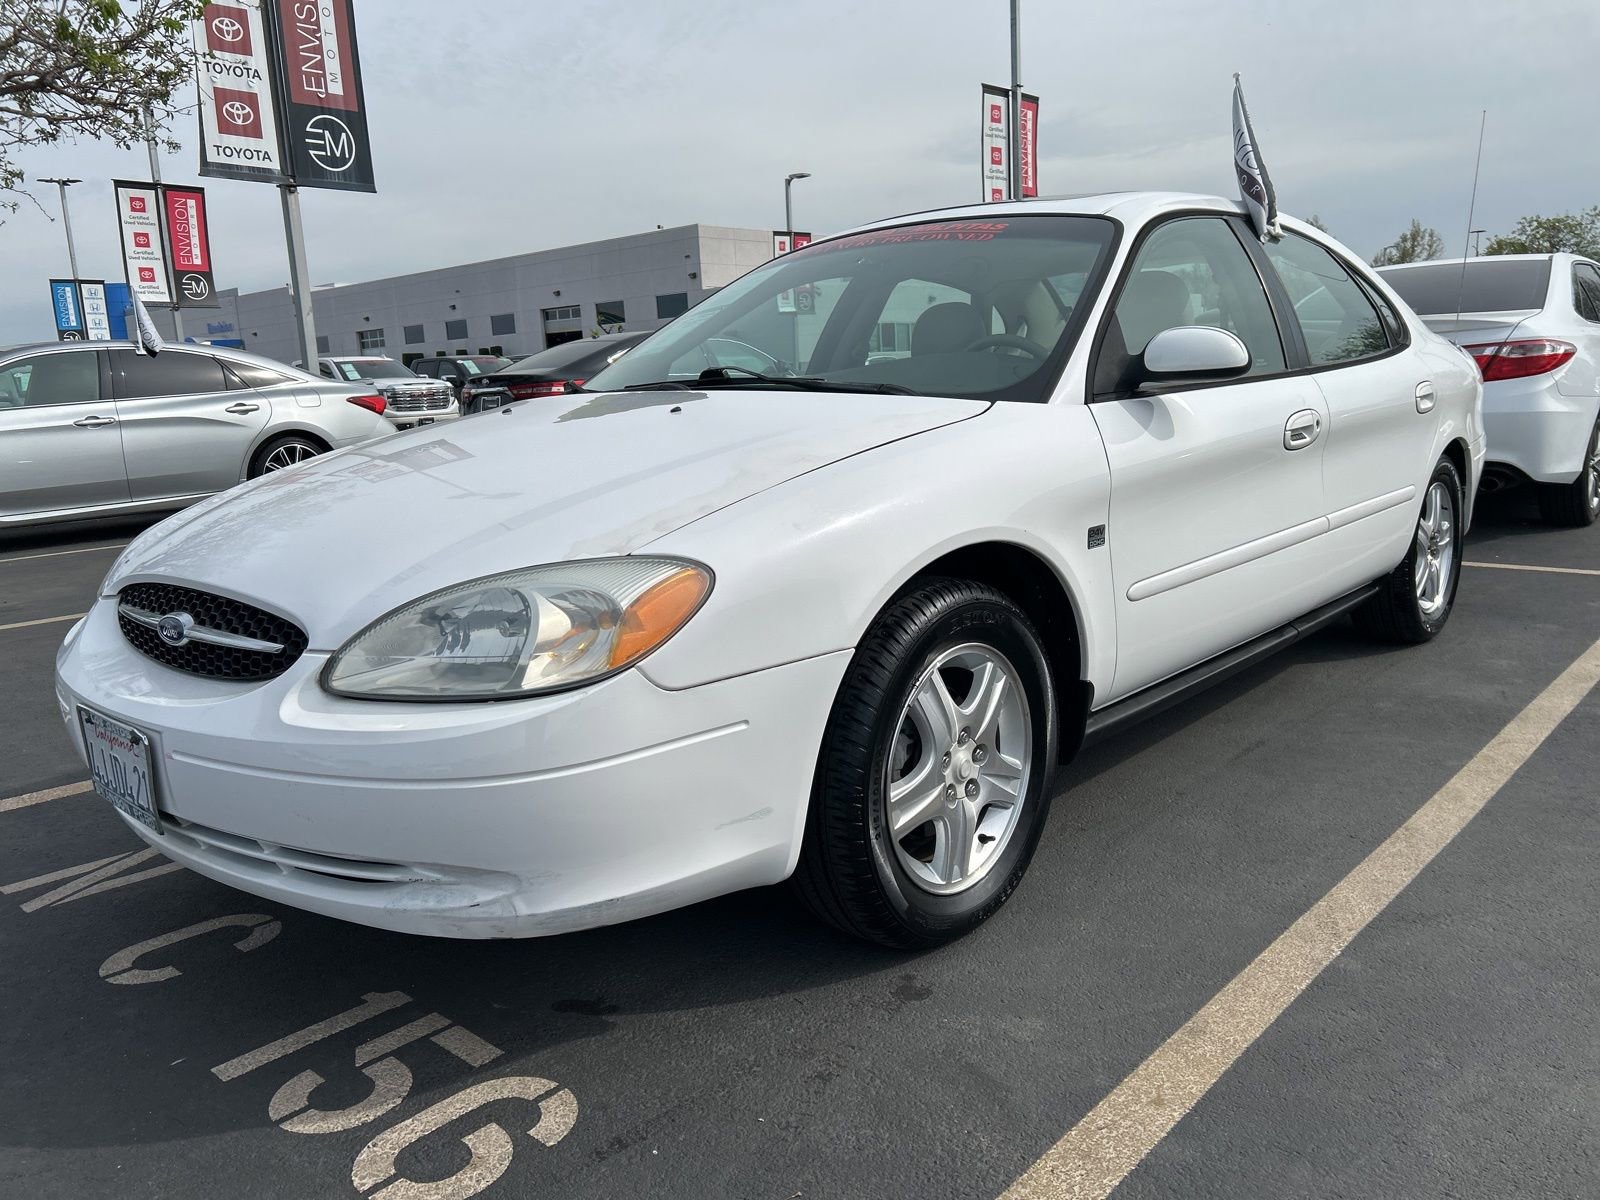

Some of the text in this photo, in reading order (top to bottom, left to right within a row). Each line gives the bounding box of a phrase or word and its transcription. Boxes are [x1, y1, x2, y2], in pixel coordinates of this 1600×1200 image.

[203, 61, 262, 81] TOYOTA
[295, 0, 325, 92] ENVIS
[213, 145, 272, 162] TOYOTA
[174, 198, 193, 265] ENVISION
[190, 205, 199, 260] MOTORS
[57, 287, 70, 327] ENVISION
[90, 742, 151, 811] 4JJD421
[99, 914, 283, 985] C
